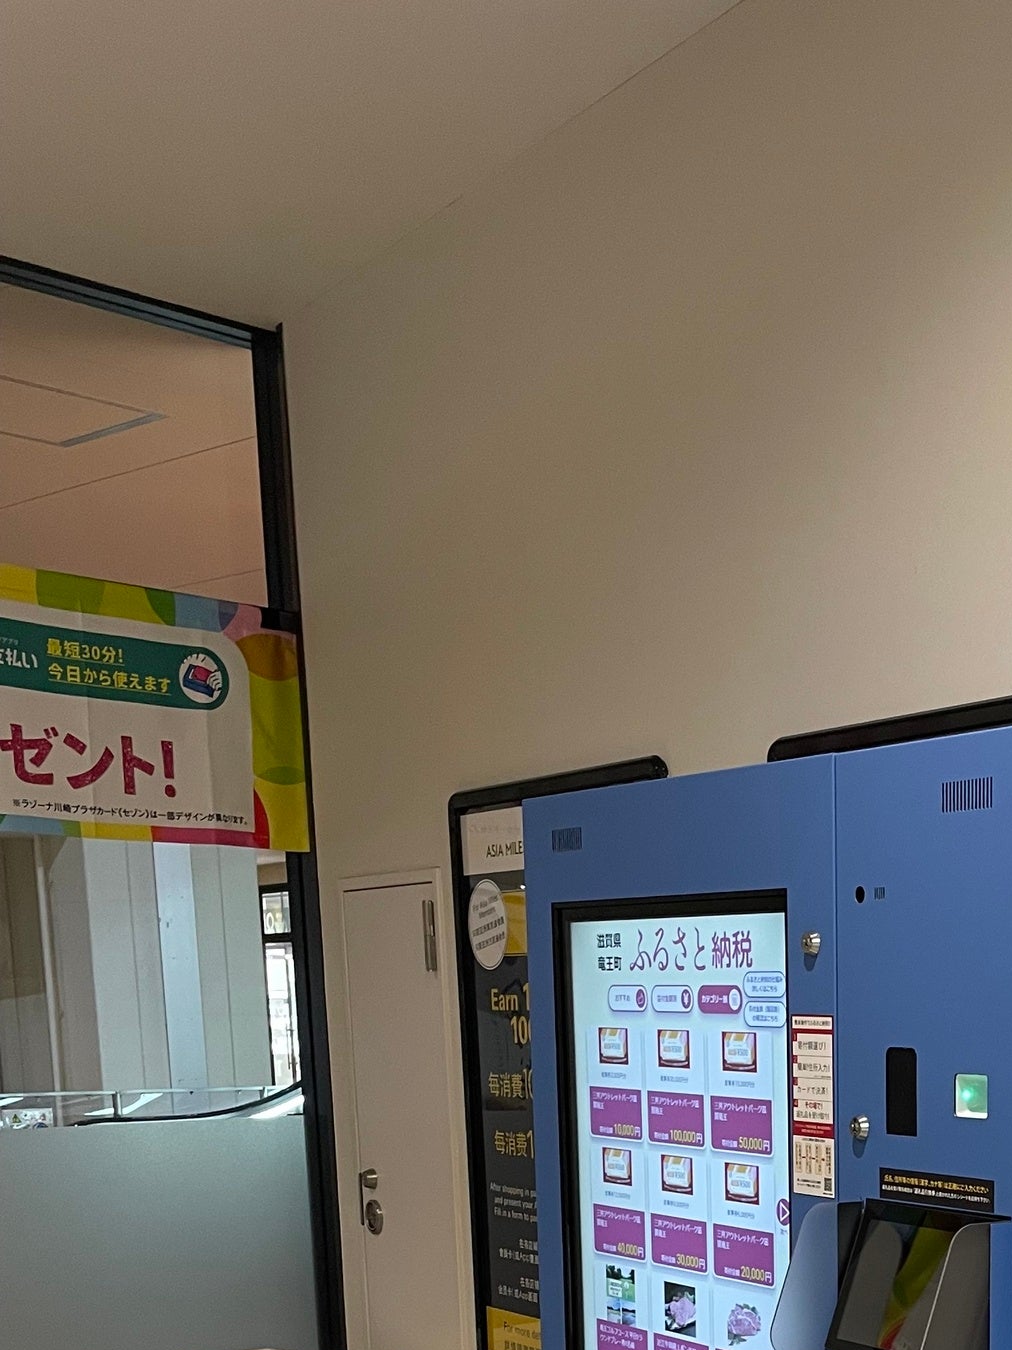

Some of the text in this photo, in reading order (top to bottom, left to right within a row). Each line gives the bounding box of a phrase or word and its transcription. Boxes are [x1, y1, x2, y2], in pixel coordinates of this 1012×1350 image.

[46, 638, 124, 664] 最短30分!
[48, 662, 171, 693] 今日から使えます
[486, 842, 504, 858] ASIA
[629, 927, 753, 972] ふるさと納税
[598, 956, 622, 972] 竜王町
[491, 988, 518, 1011] Earn
[613, 1122, 641, 1137] 10,000円
[669, 1129, 703, 1144] 100,000円
[738, 1136, 770, 1152] 50,000円
[676, 1253, 706, 1269] 30,000円
[740, 1265, 772, 1283] 20,000円
